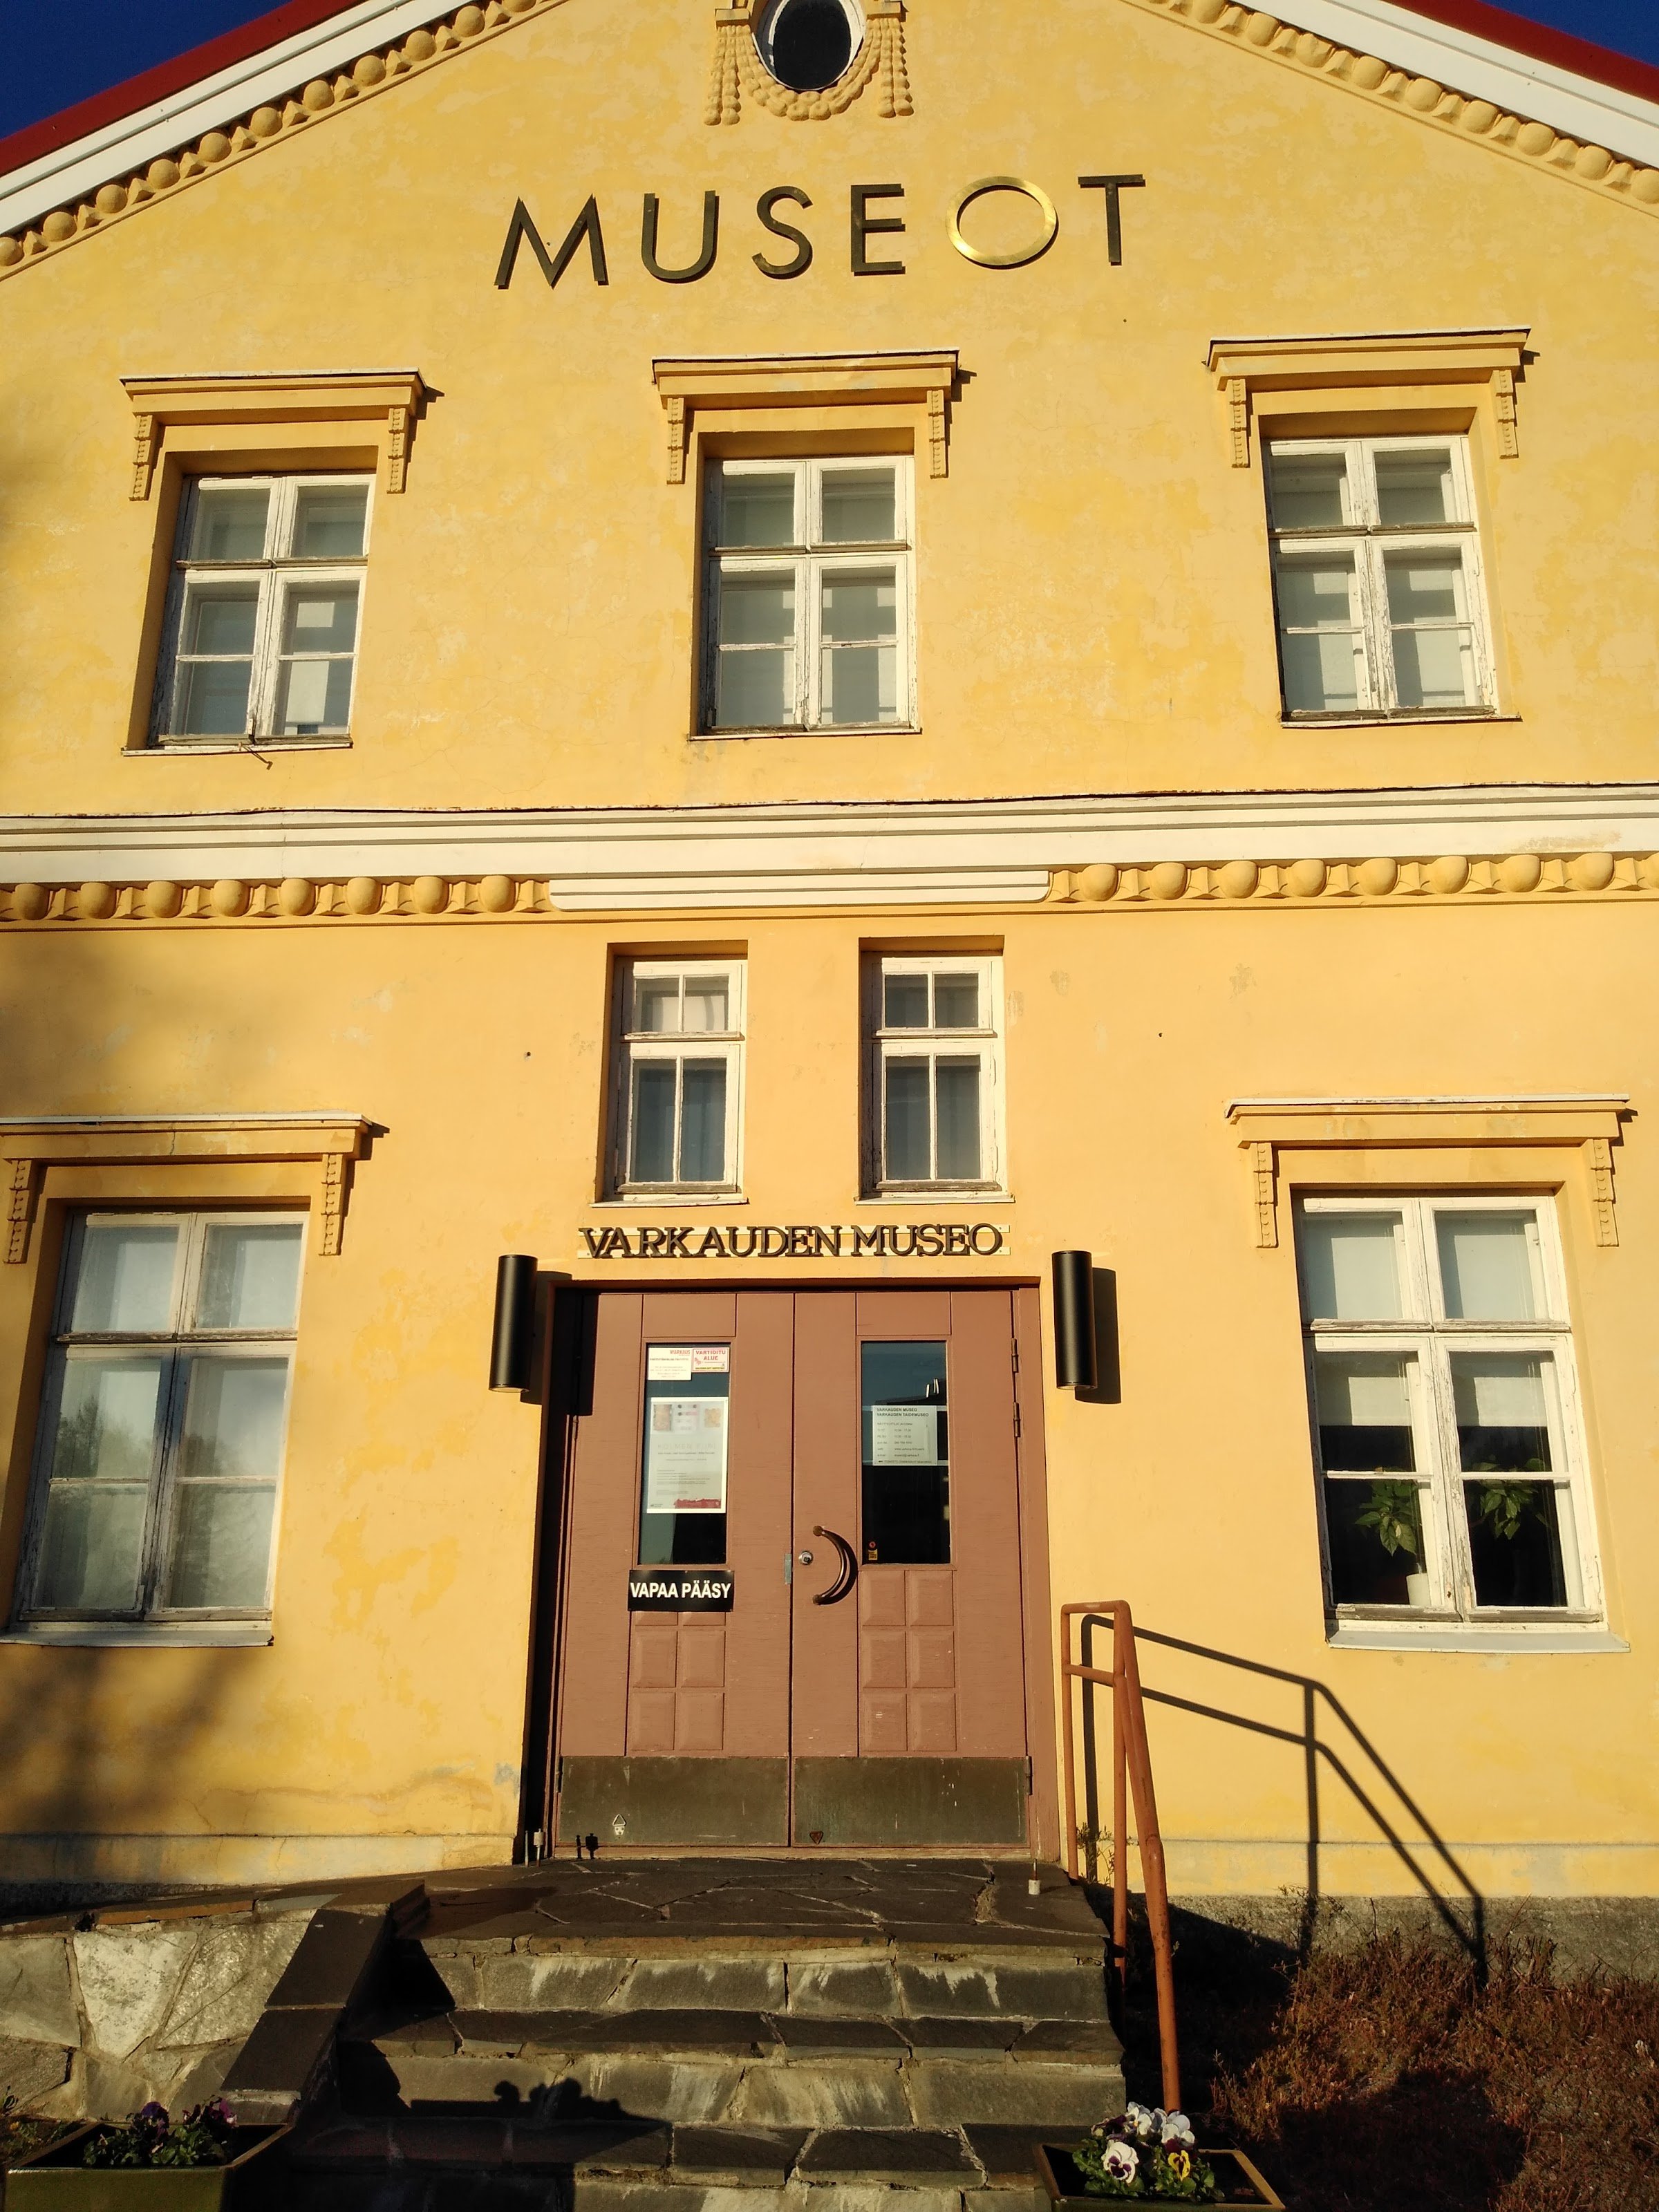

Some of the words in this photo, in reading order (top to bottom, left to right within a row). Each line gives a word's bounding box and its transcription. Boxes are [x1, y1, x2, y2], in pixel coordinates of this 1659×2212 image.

[494, 174, 1146, 290] MUSEOT
[579, 1226, 841, 1258] VARKAUDEN
[850, 1222, 1004, 1257] MUSEO
[630, 1582, 679, 1598] VAPAA
[681, 1580, 731, 1599] PÄÄSY
